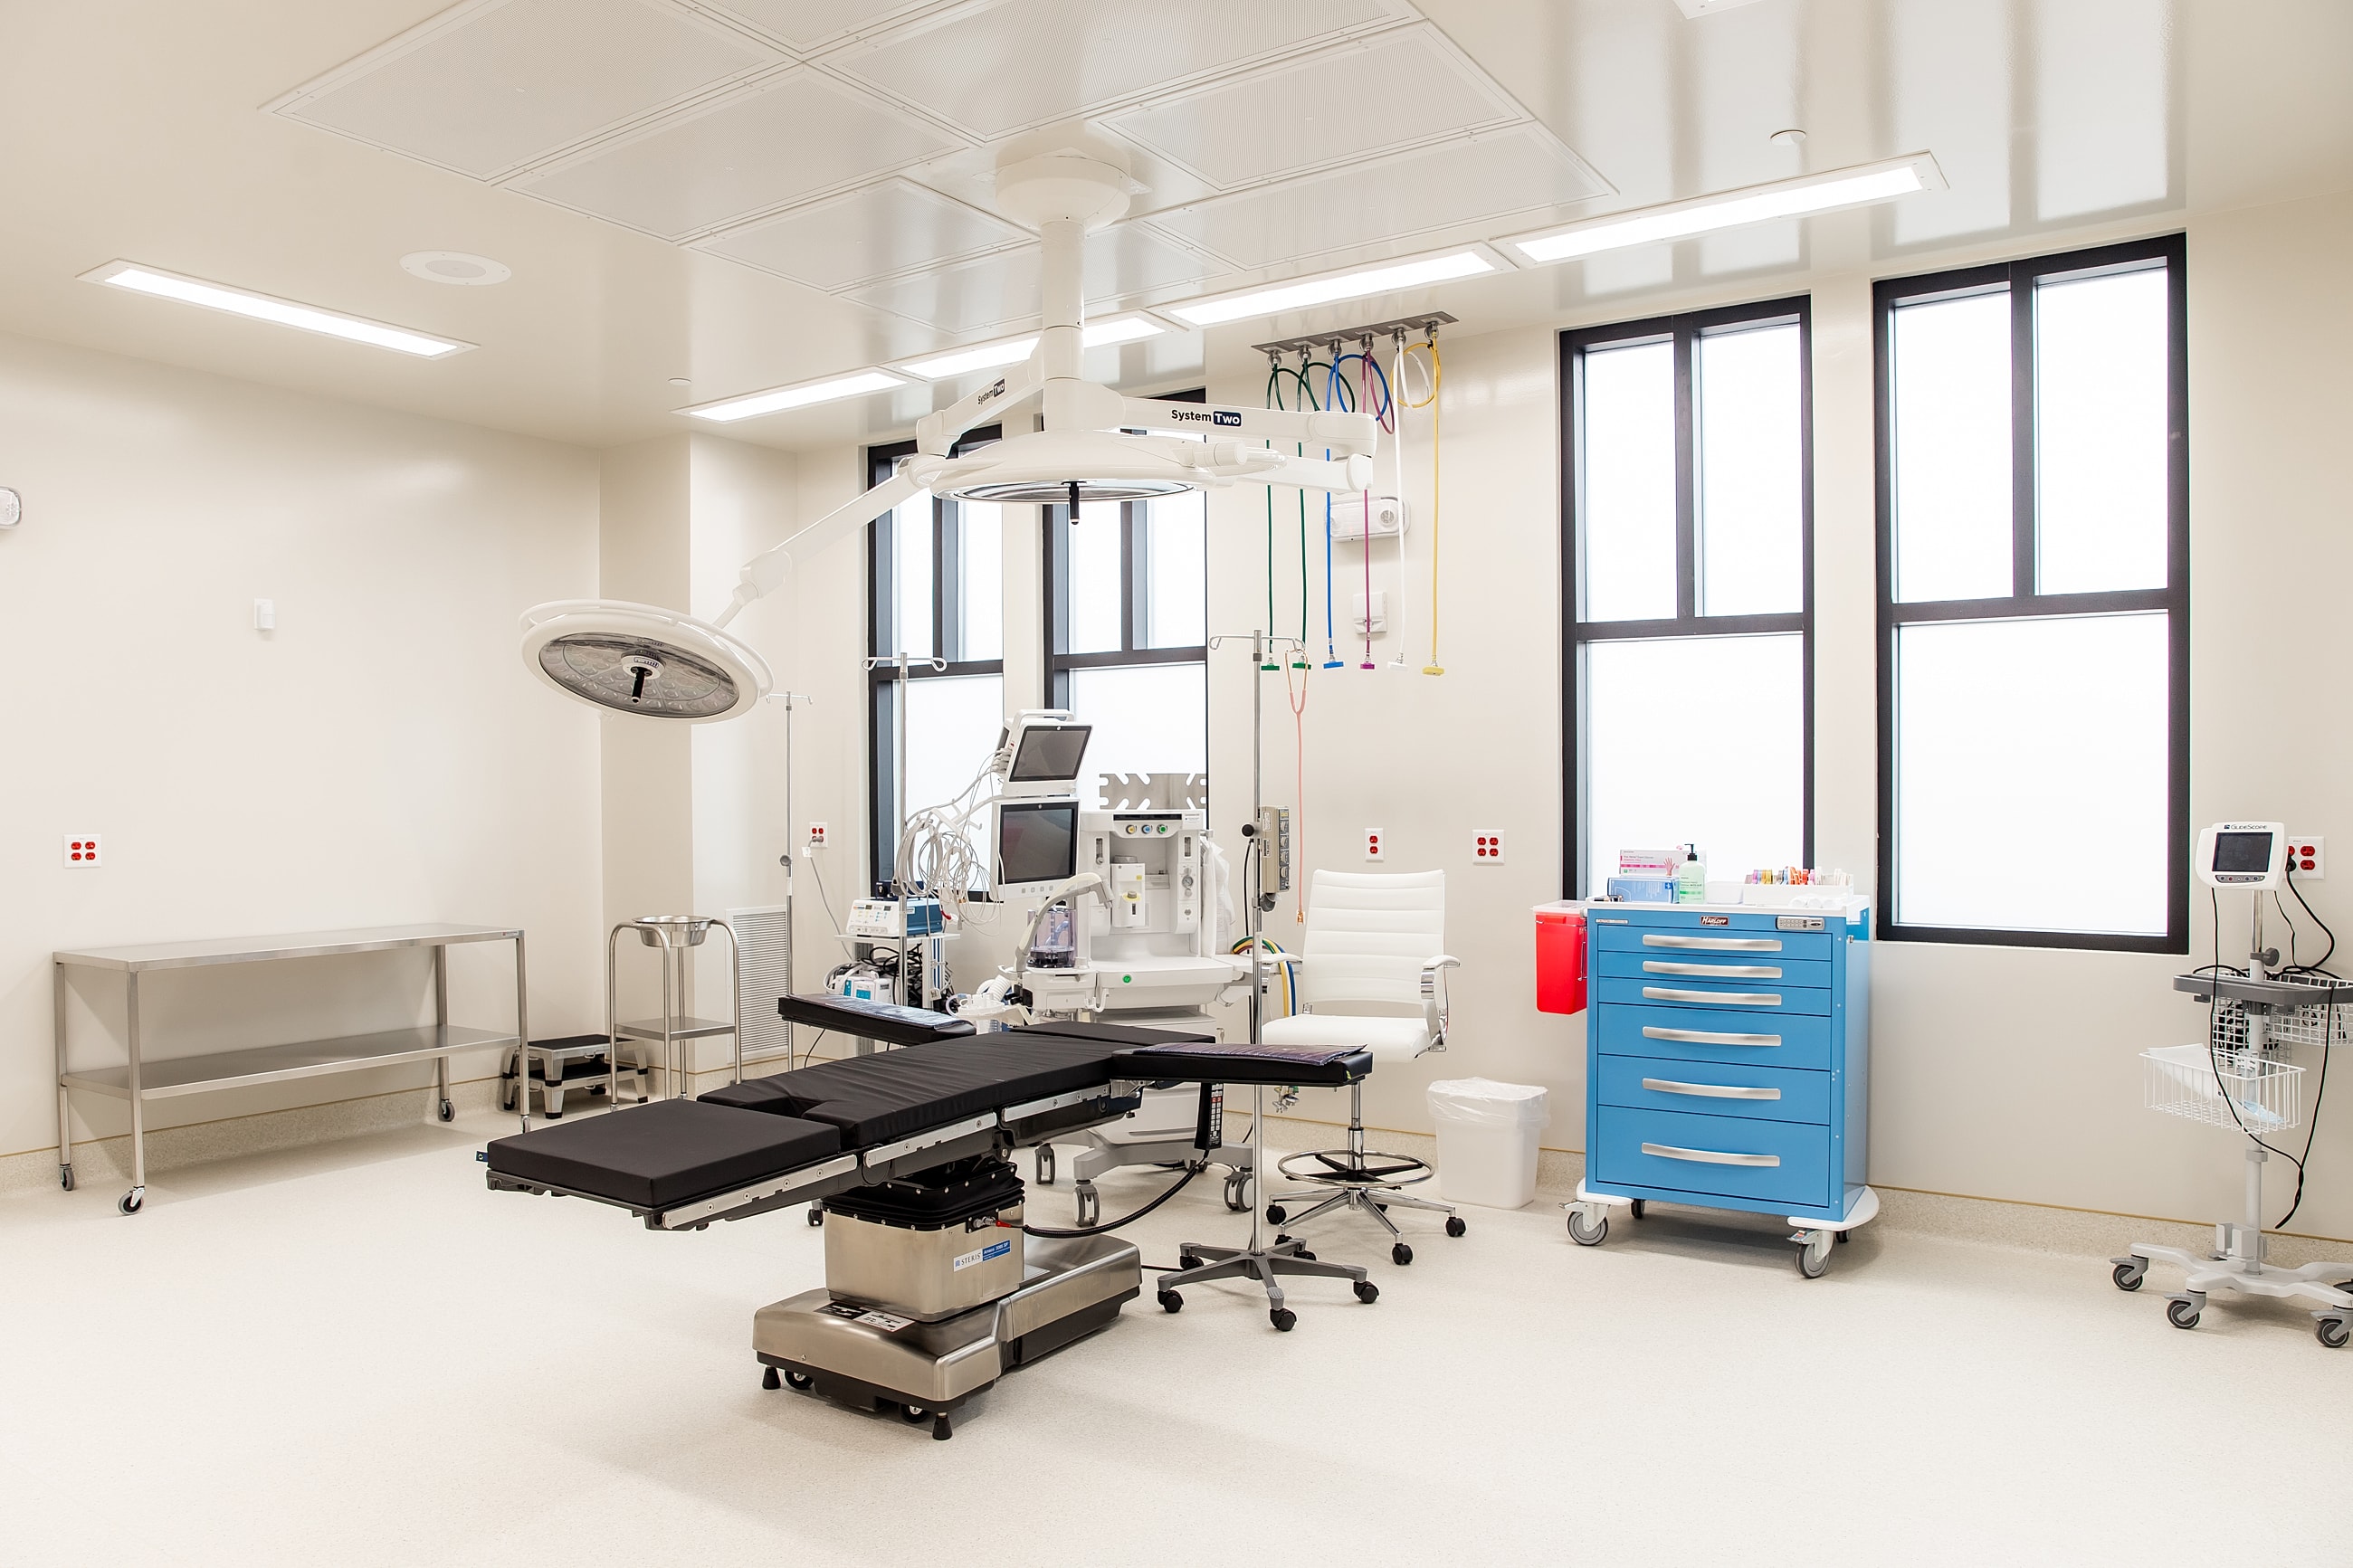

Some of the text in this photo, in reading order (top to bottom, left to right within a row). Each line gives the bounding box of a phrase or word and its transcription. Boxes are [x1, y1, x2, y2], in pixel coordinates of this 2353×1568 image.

[978, 383, 1005, 404] System Two
[1171, 410, 1240, 424] System Two
[961, 1252, 981, 1265] STERIS
